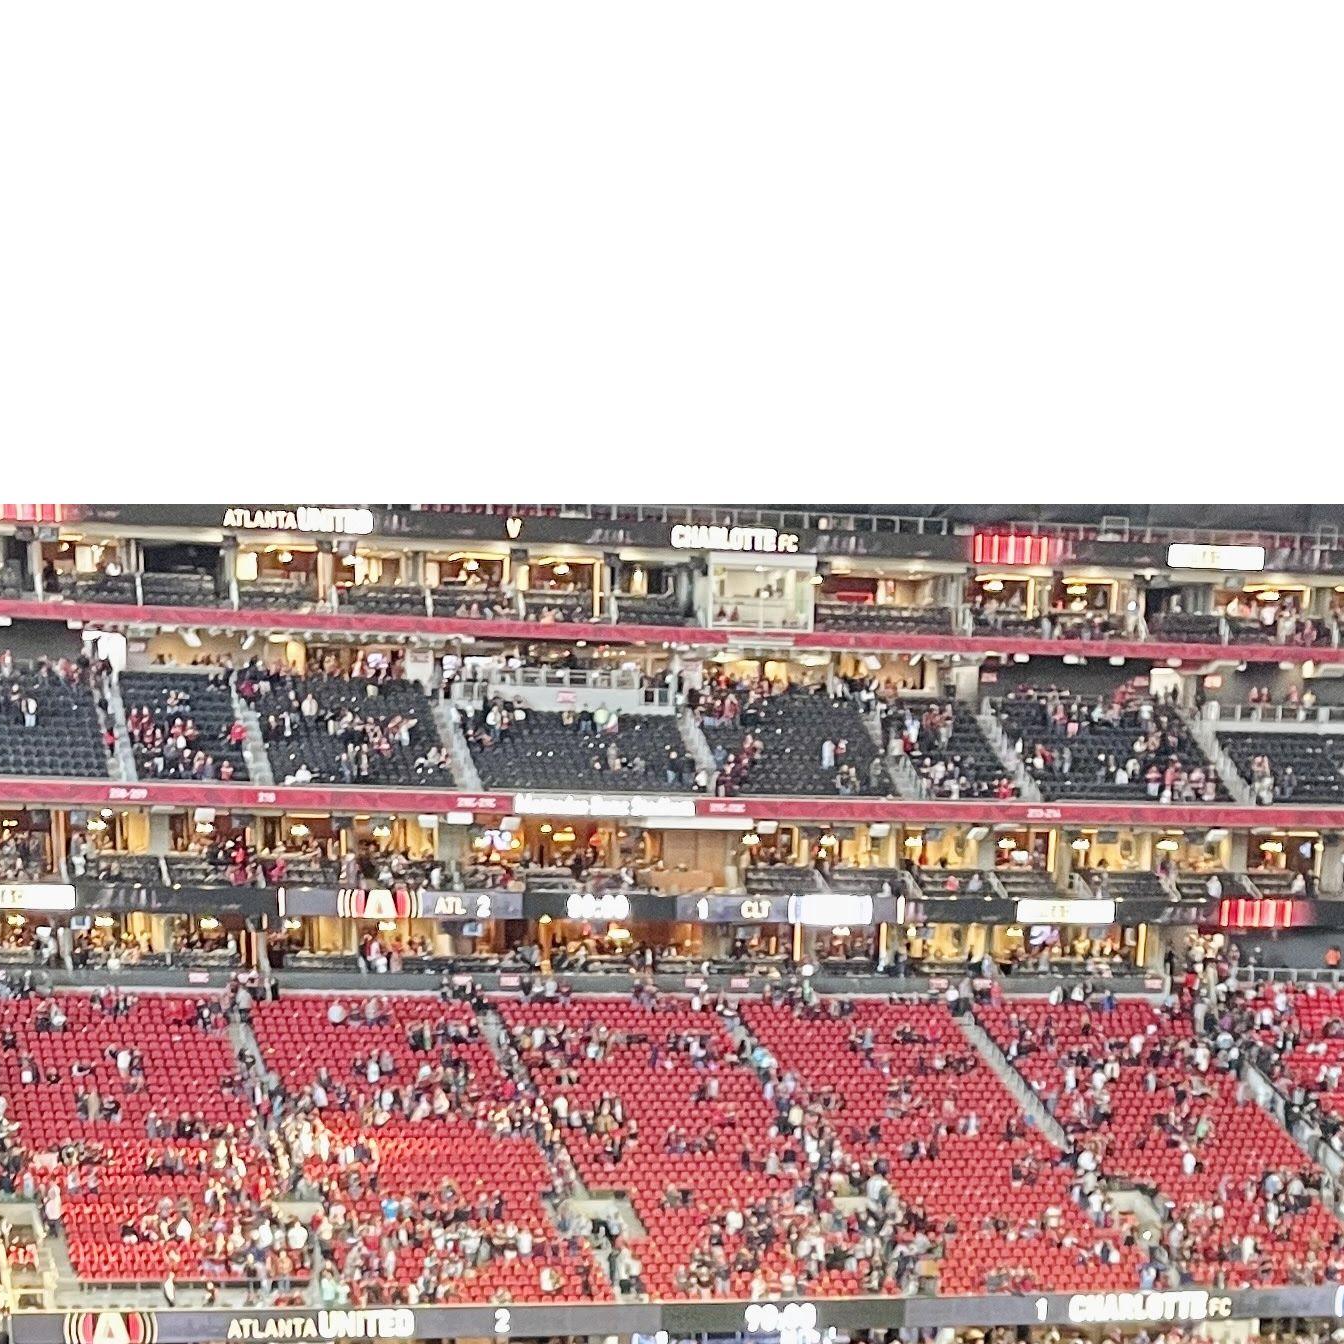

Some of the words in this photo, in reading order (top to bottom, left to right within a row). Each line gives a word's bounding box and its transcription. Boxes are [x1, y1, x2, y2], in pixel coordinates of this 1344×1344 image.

[223, 508, 296, 530] ATLANTA
[296, 506, 373, 534] UNITED
[777, 534, 799, 552] FC
[435, 897, 467, 915] ATL
[1068, 1291, 1208, 1322] CHARLOTTE
[1208, 1299, 1232, 1318] FC
[226, 1316, 318, 1340] ATLANTA
[318, 1308, 414, 1338] UNITED
[494, 1308, 511, 1333] 2
